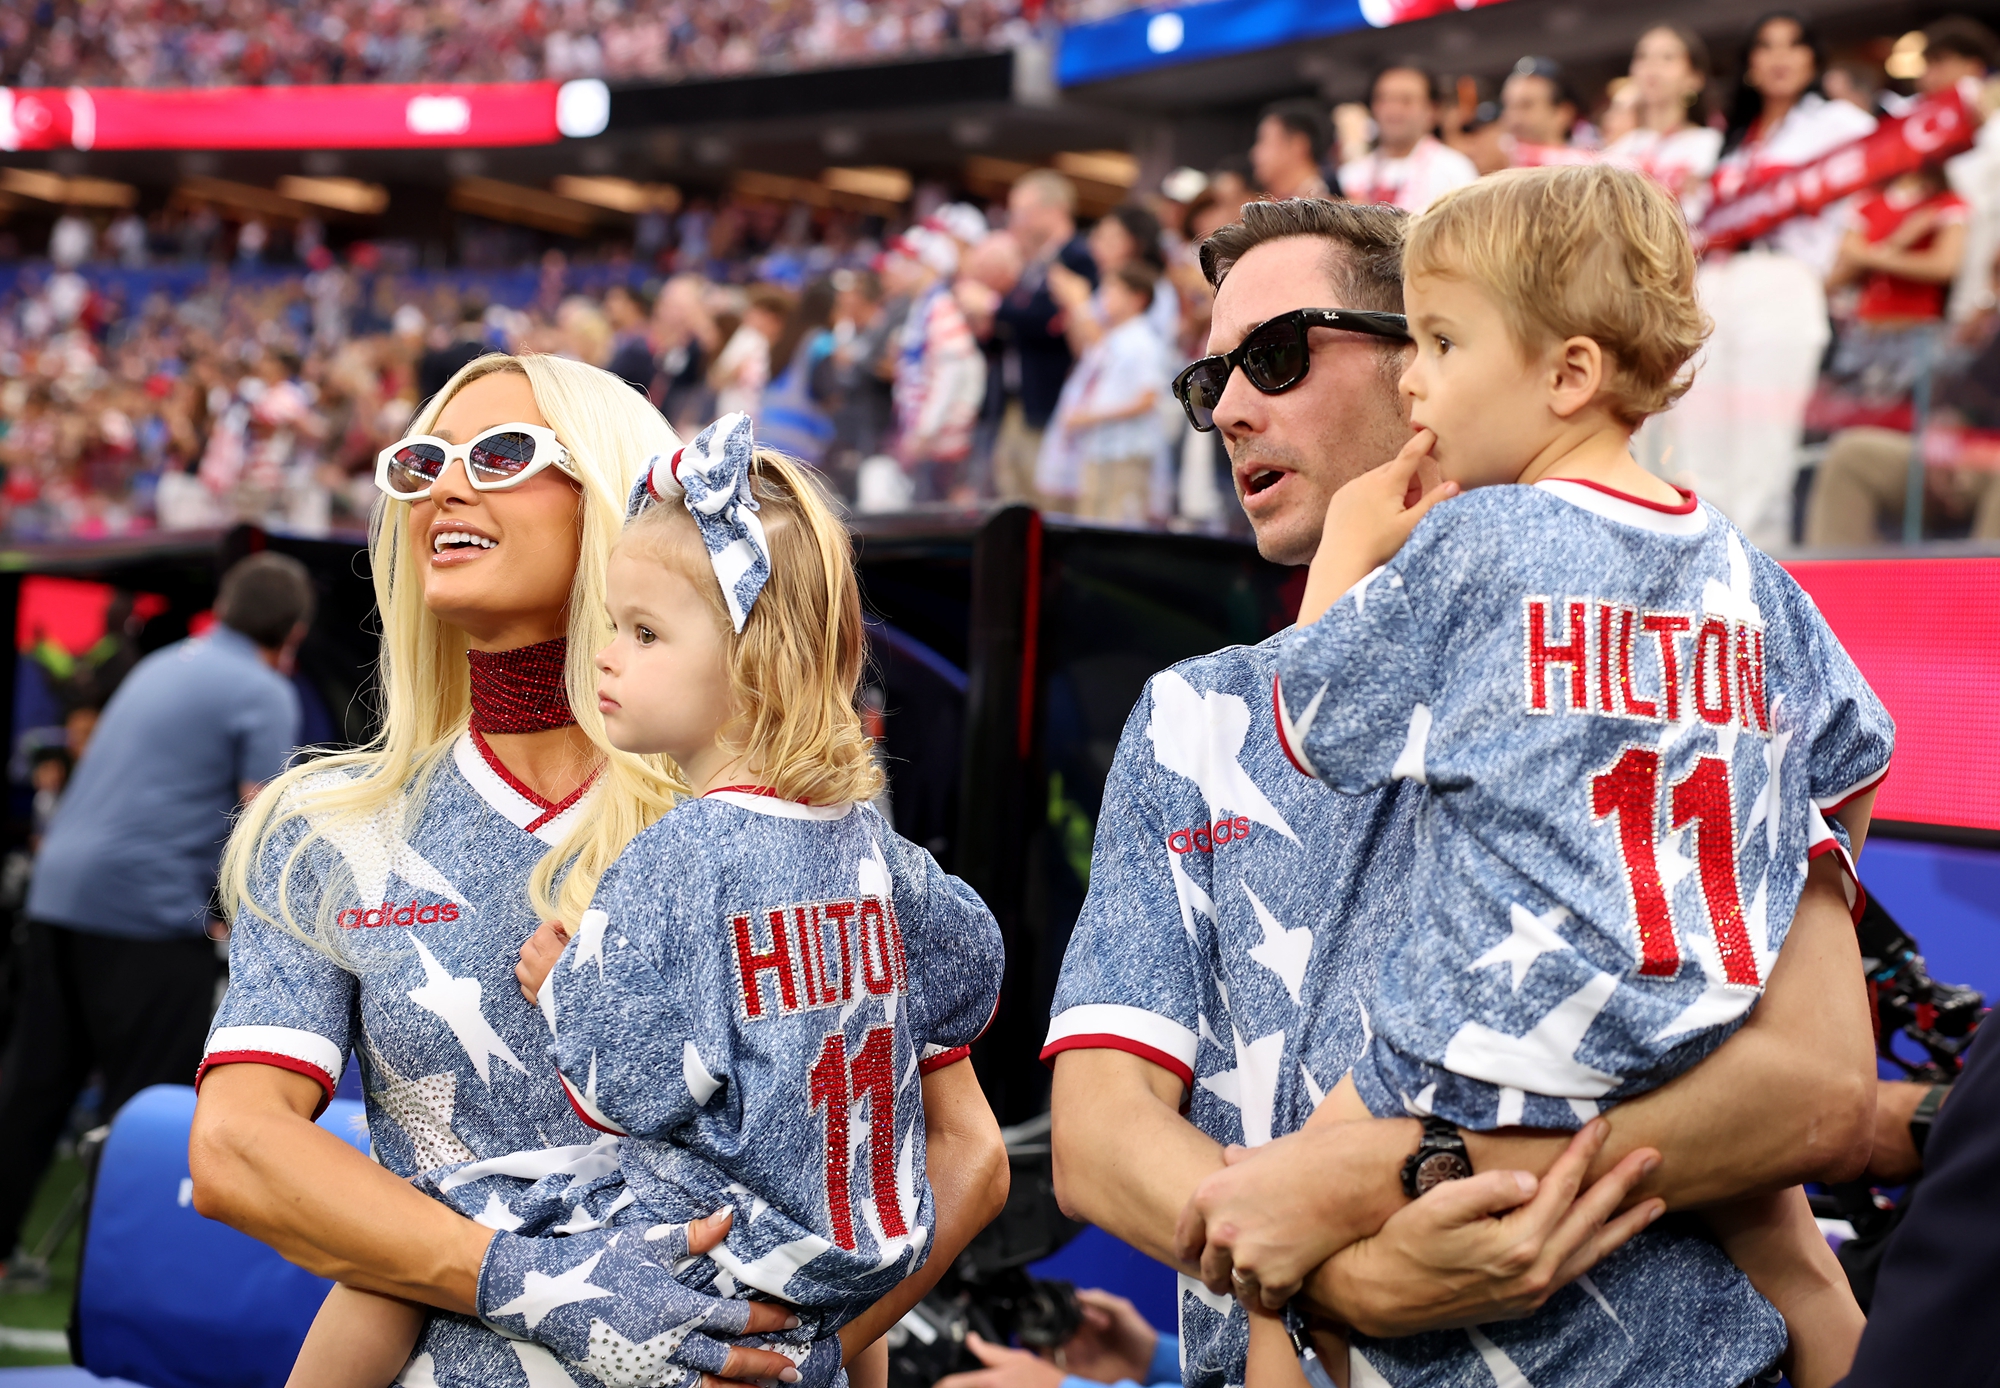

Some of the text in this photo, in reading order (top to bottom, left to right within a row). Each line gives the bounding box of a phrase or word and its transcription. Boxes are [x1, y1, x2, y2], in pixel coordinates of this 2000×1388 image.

[1523, 595, 1772, 737] HILTON
[1168, 816, 1250, 854] adas
[1587, 741, 1764, 991] 11
[337, 900, 459, 929] adidas
[807, 1021, 908, 1254] 11
